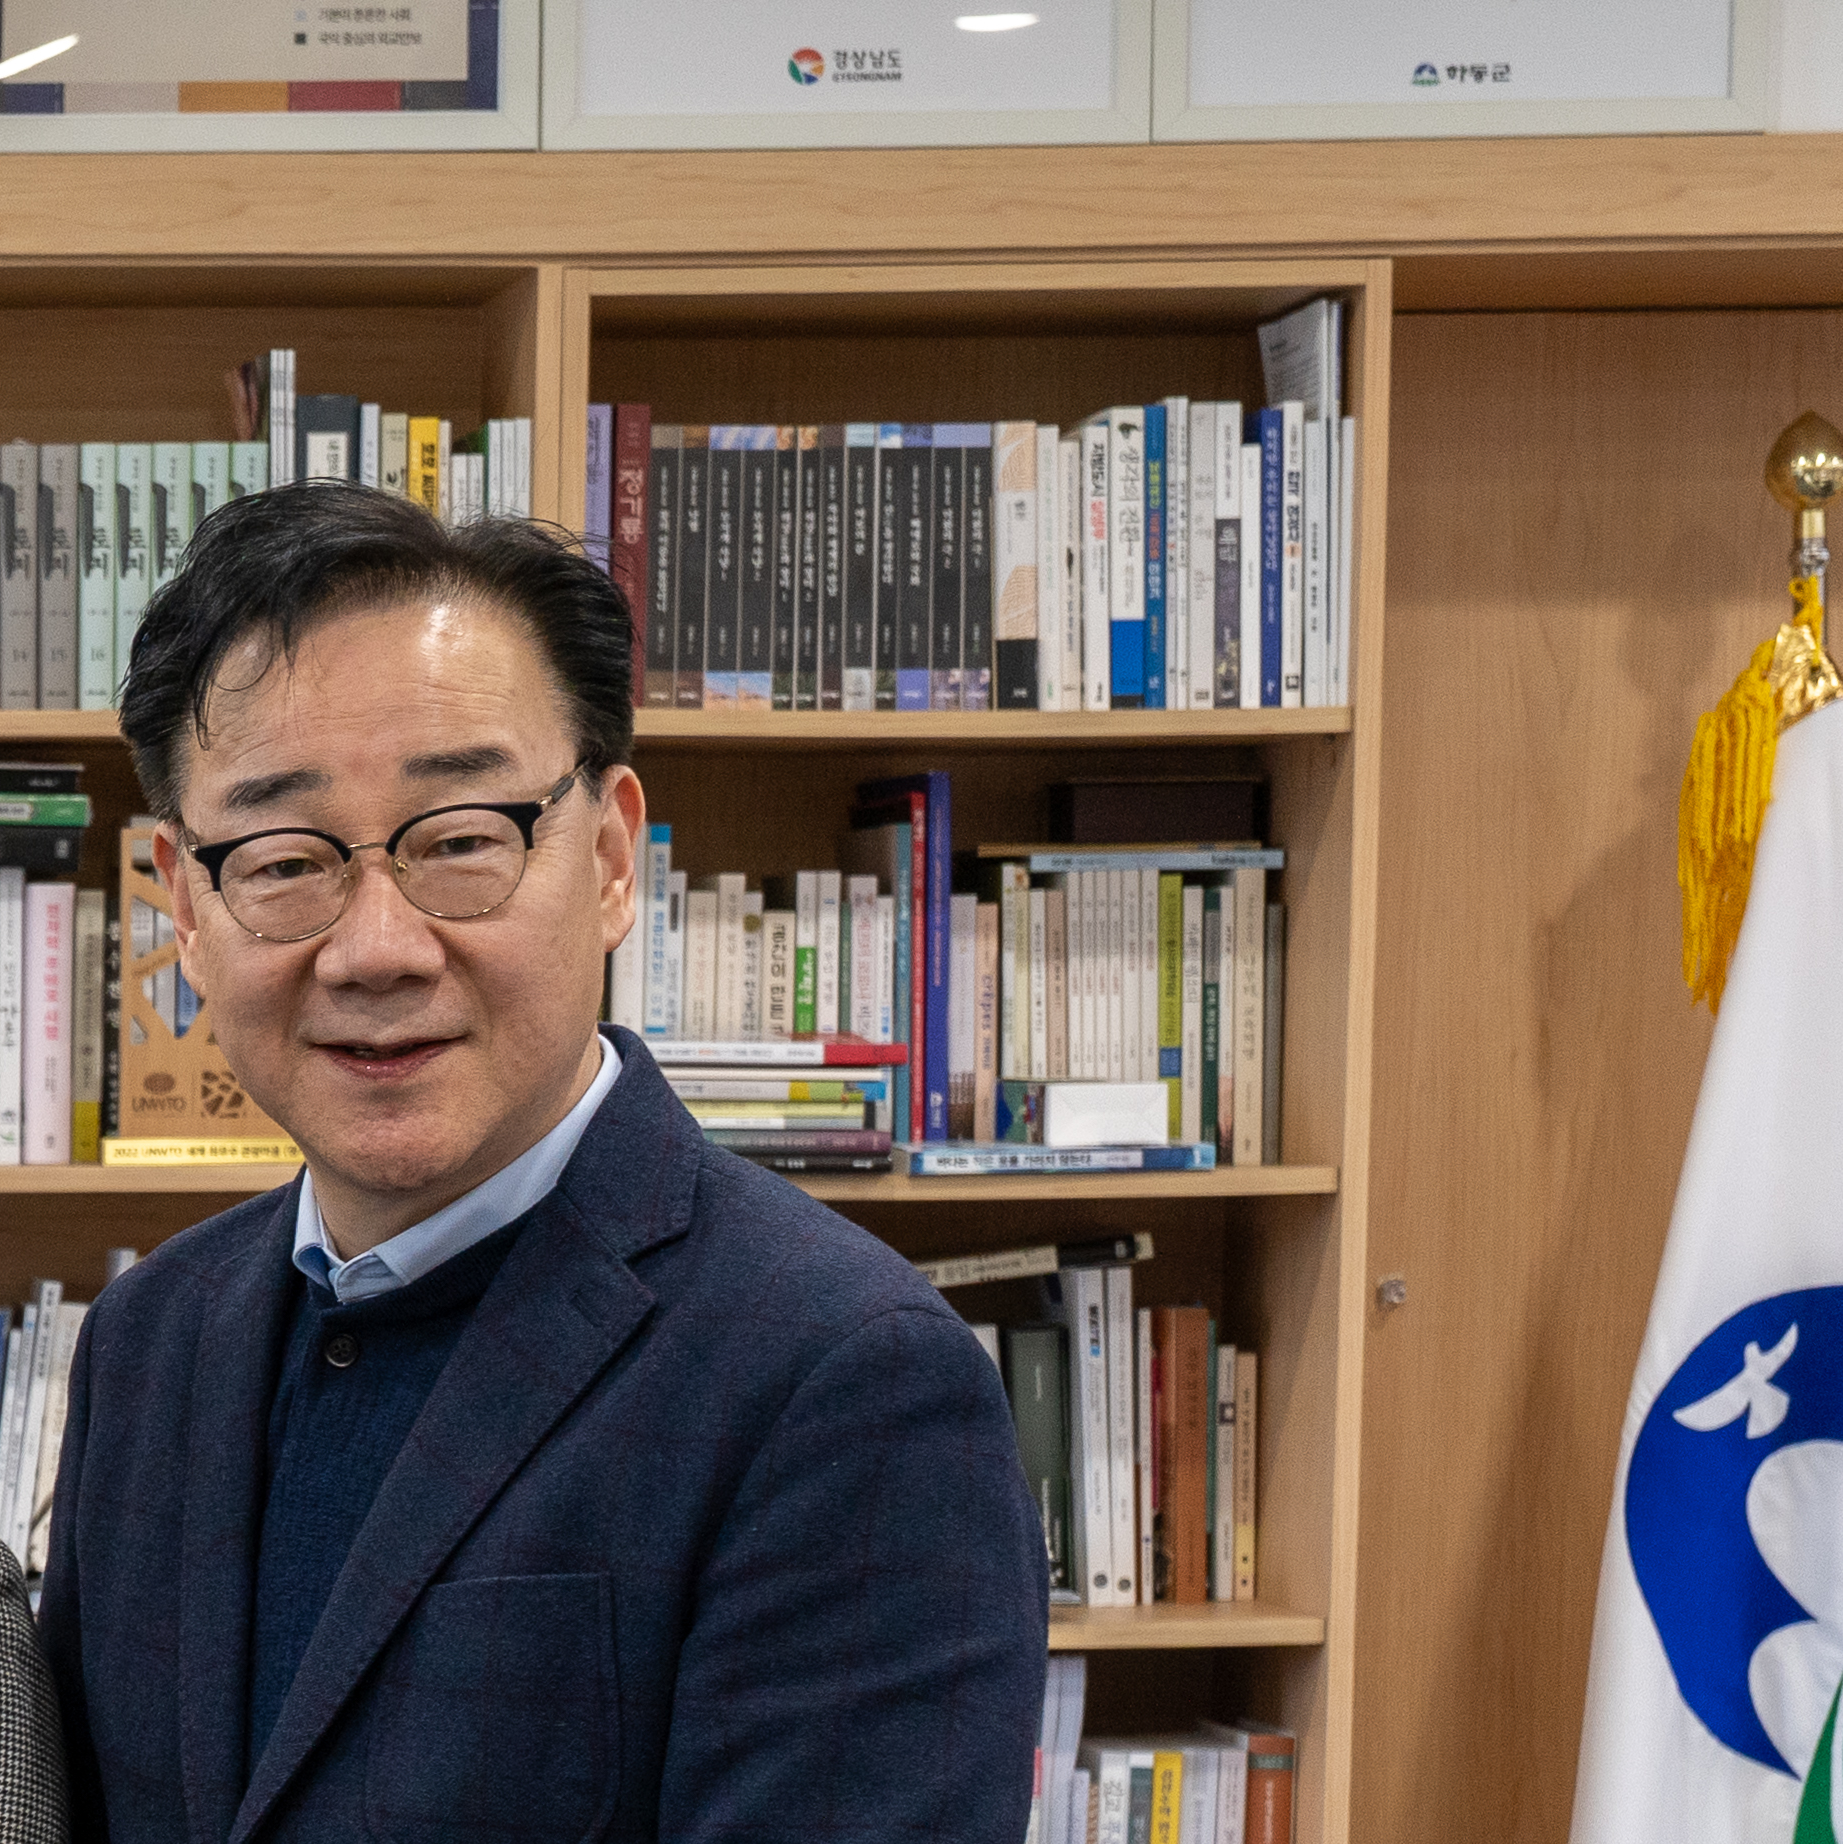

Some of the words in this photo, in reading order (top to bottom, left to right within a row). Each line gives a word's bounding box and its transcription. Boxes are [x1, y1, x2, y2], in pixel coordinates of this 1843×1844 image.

[833, 49, 901, 70] 경상남도
[1446, 63, 1511, 83] 하동군
[1118, 446, 1141, 502] 생각의
[1118, 506, 1141, 543] 전환
[134, 1098, 185, 1112] UNWTO
[936, 1155, 969, 1167] 바다는
[1059, 1153, 1092, 1167] 않는다
